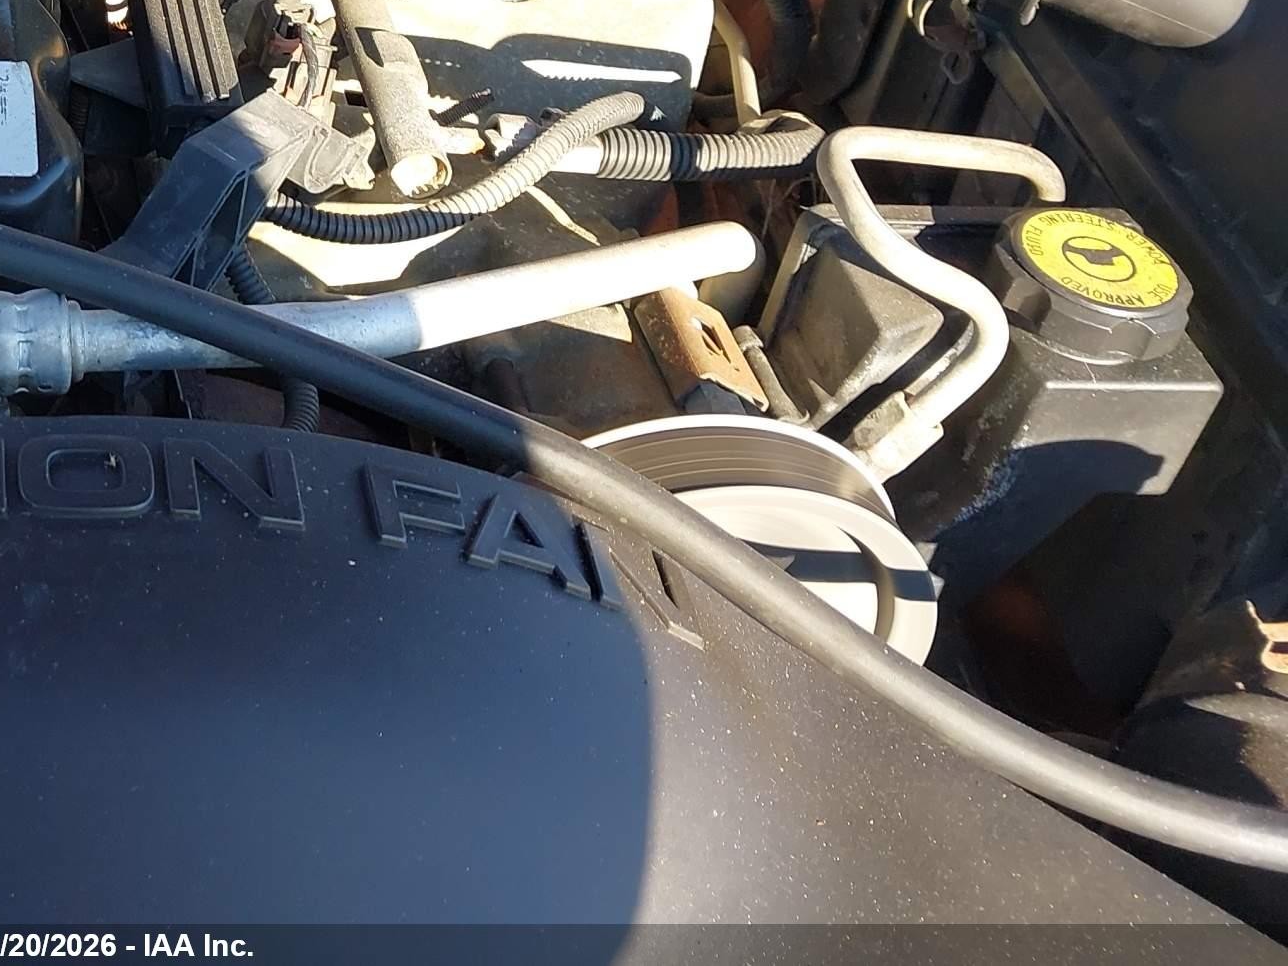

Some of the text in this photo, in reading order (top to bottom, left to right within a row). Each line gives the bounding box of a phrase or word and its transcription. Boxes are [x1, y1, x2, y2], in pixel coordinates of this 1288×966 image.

[1039, 211, 1118, 232] STEERING
[1060, 275, 1172, 306] USE APPROVED
